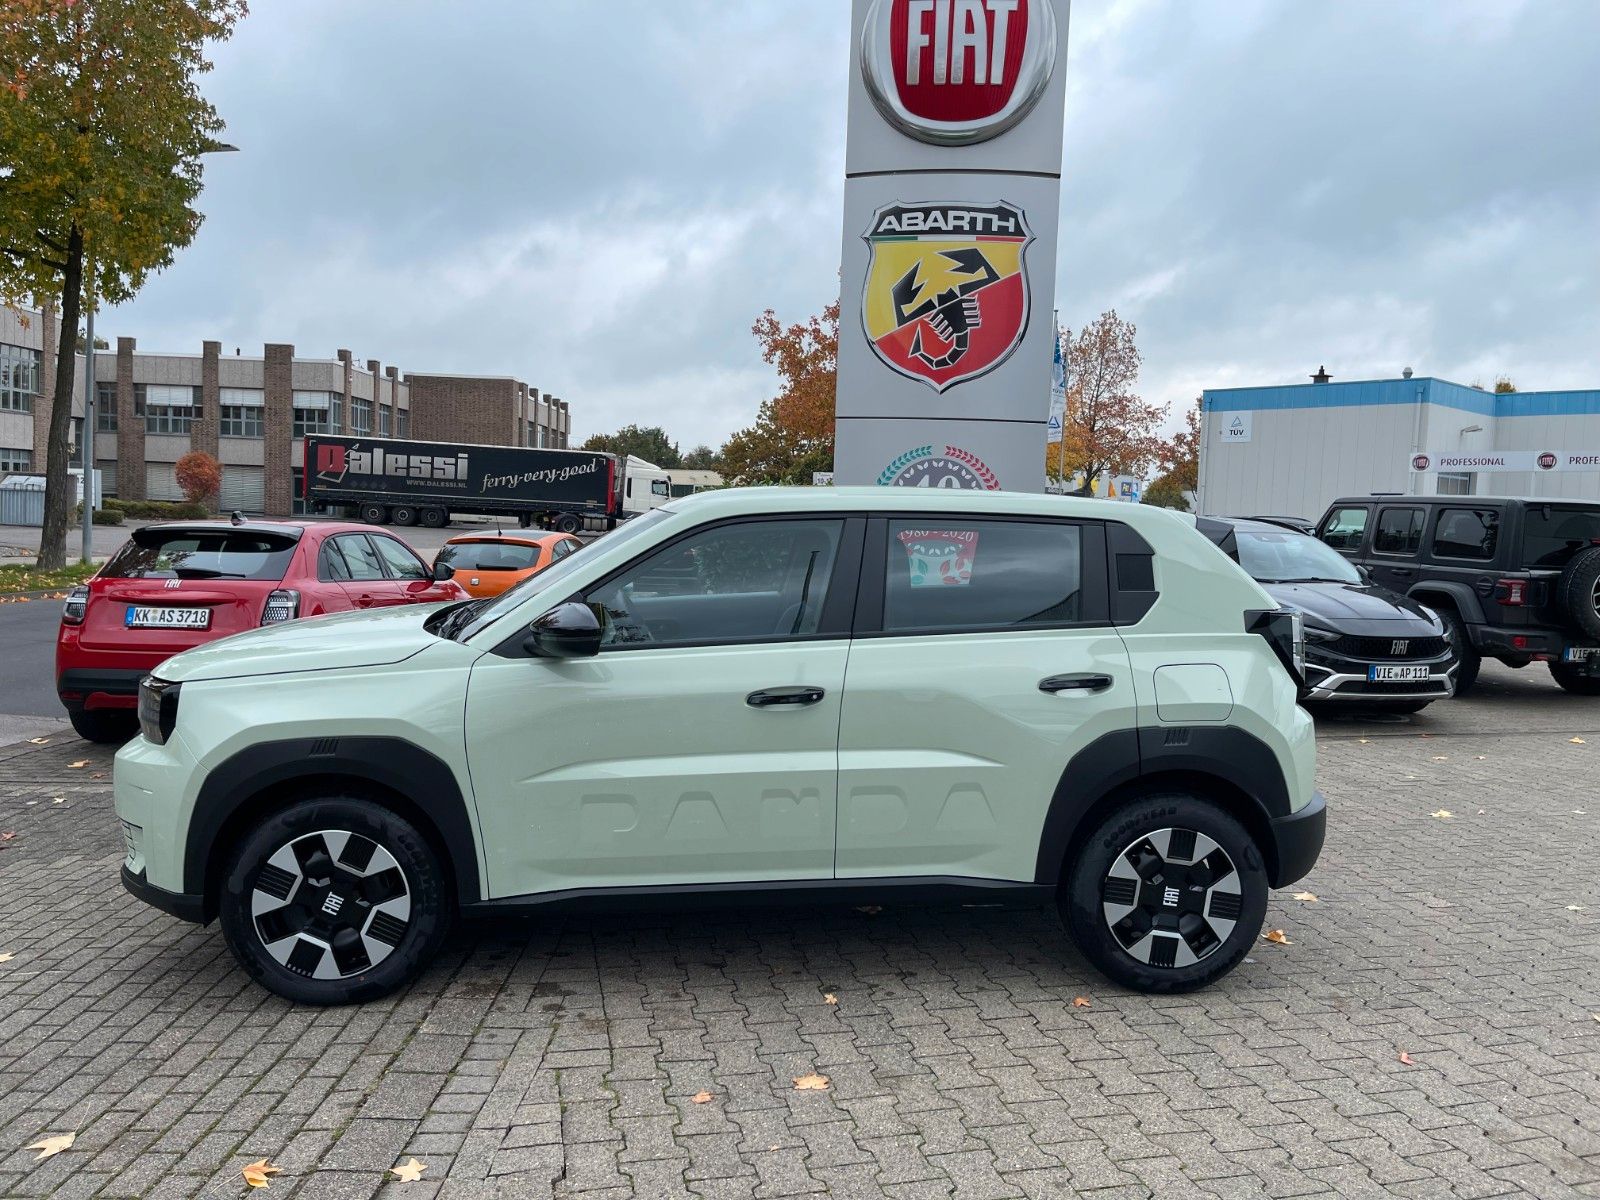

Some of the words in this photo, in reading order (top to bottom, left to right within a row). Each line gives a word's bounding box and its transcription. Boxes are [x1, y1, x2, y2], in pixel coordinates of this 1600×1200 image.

[906, 0, 1018, 85] FIAT
[877, 210, 1015, 233] ABARTH
[1440, 458, 1505, 466] PROFESSIONAL
[1569, 456, 1600, 465] PROFE
[480, 458, 599, 493] ferry-very-good
[406, 479, 468, 488] WWW.DALESSI.NL
[164, 579, 183, 588] FIAT
[134, 609, 151, 622] KK
[158, 610, 175, 622] AS
[176, 610, 207, 623] 3718
[1390, 640, 1410, 655] FIAT
[1572, 648, 1588, 660] VIE
[1376, 667, 1393, 679] VIE
[1399, 667, 1411, 679] AP
[1412, 667, 1428, 679] 111
[321, 891, 345, 916] FIAT
[1163, 886, 1180, 907] FIAT
